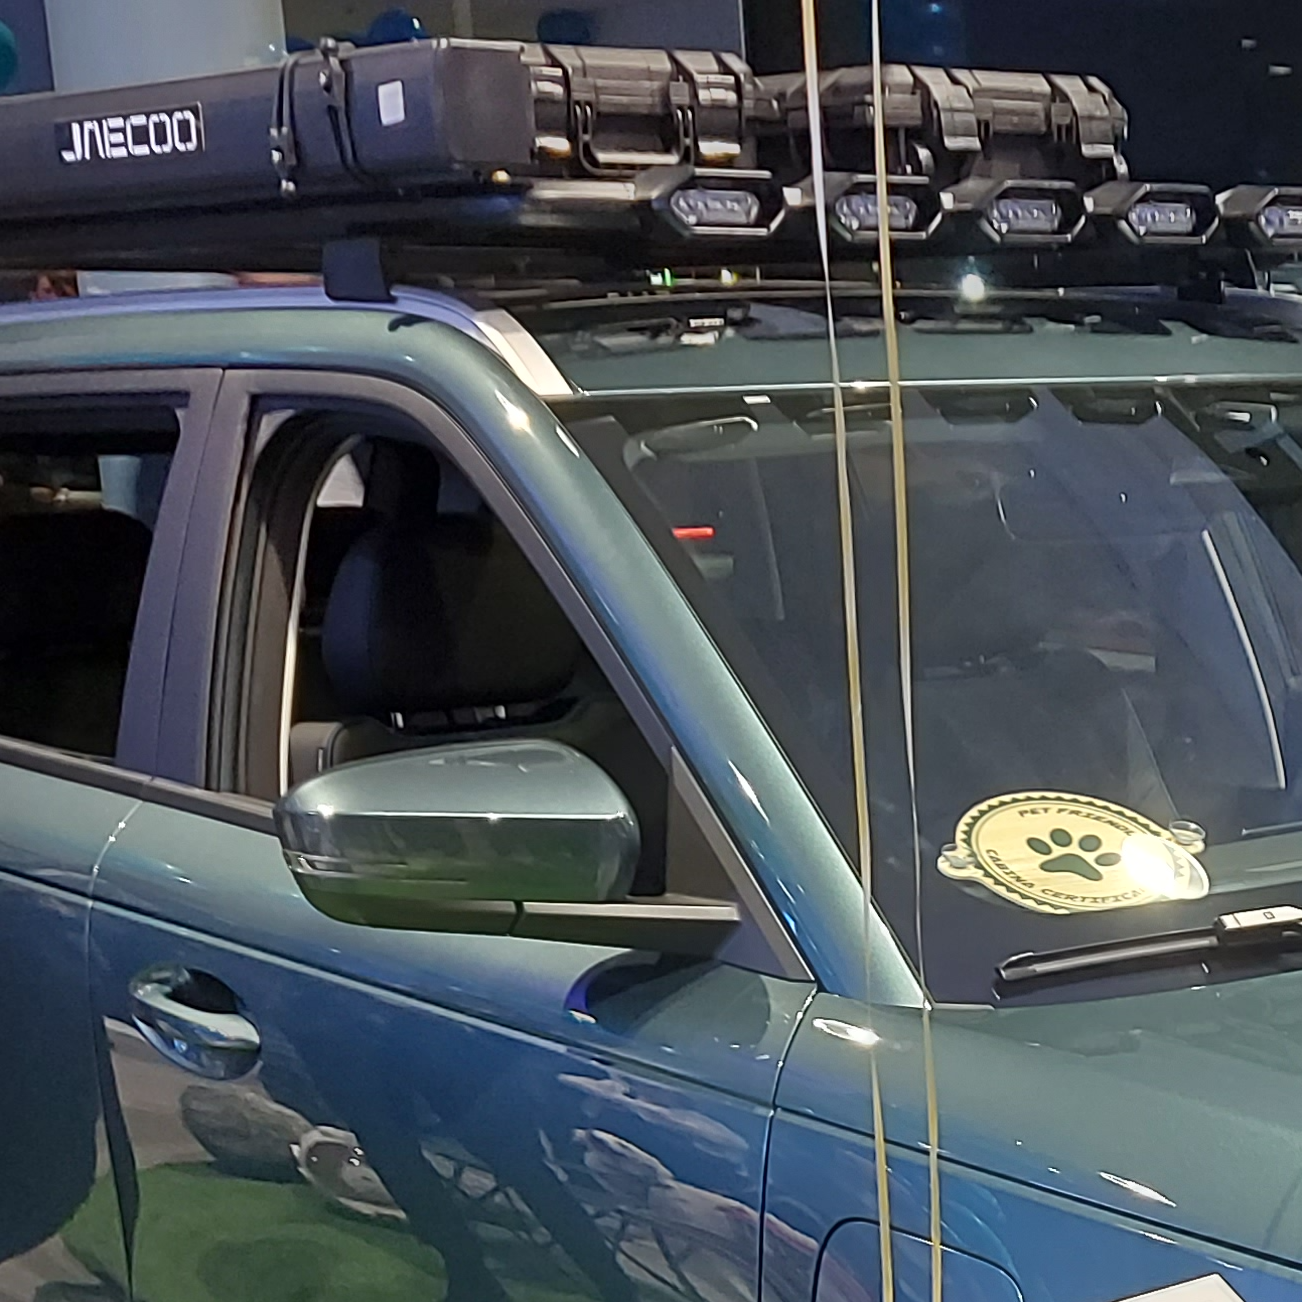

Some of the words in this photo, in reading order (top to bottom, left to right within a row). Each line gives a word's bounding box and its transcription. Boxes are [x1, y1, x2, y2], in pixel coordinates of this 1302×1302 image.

[60, 110, 198, 162] JAECOO
[1018, 807, 1052, 818] PET
[1056, 807, 1137, 837] FRIENDL
[985, 848, 1036, 889] CABINA
